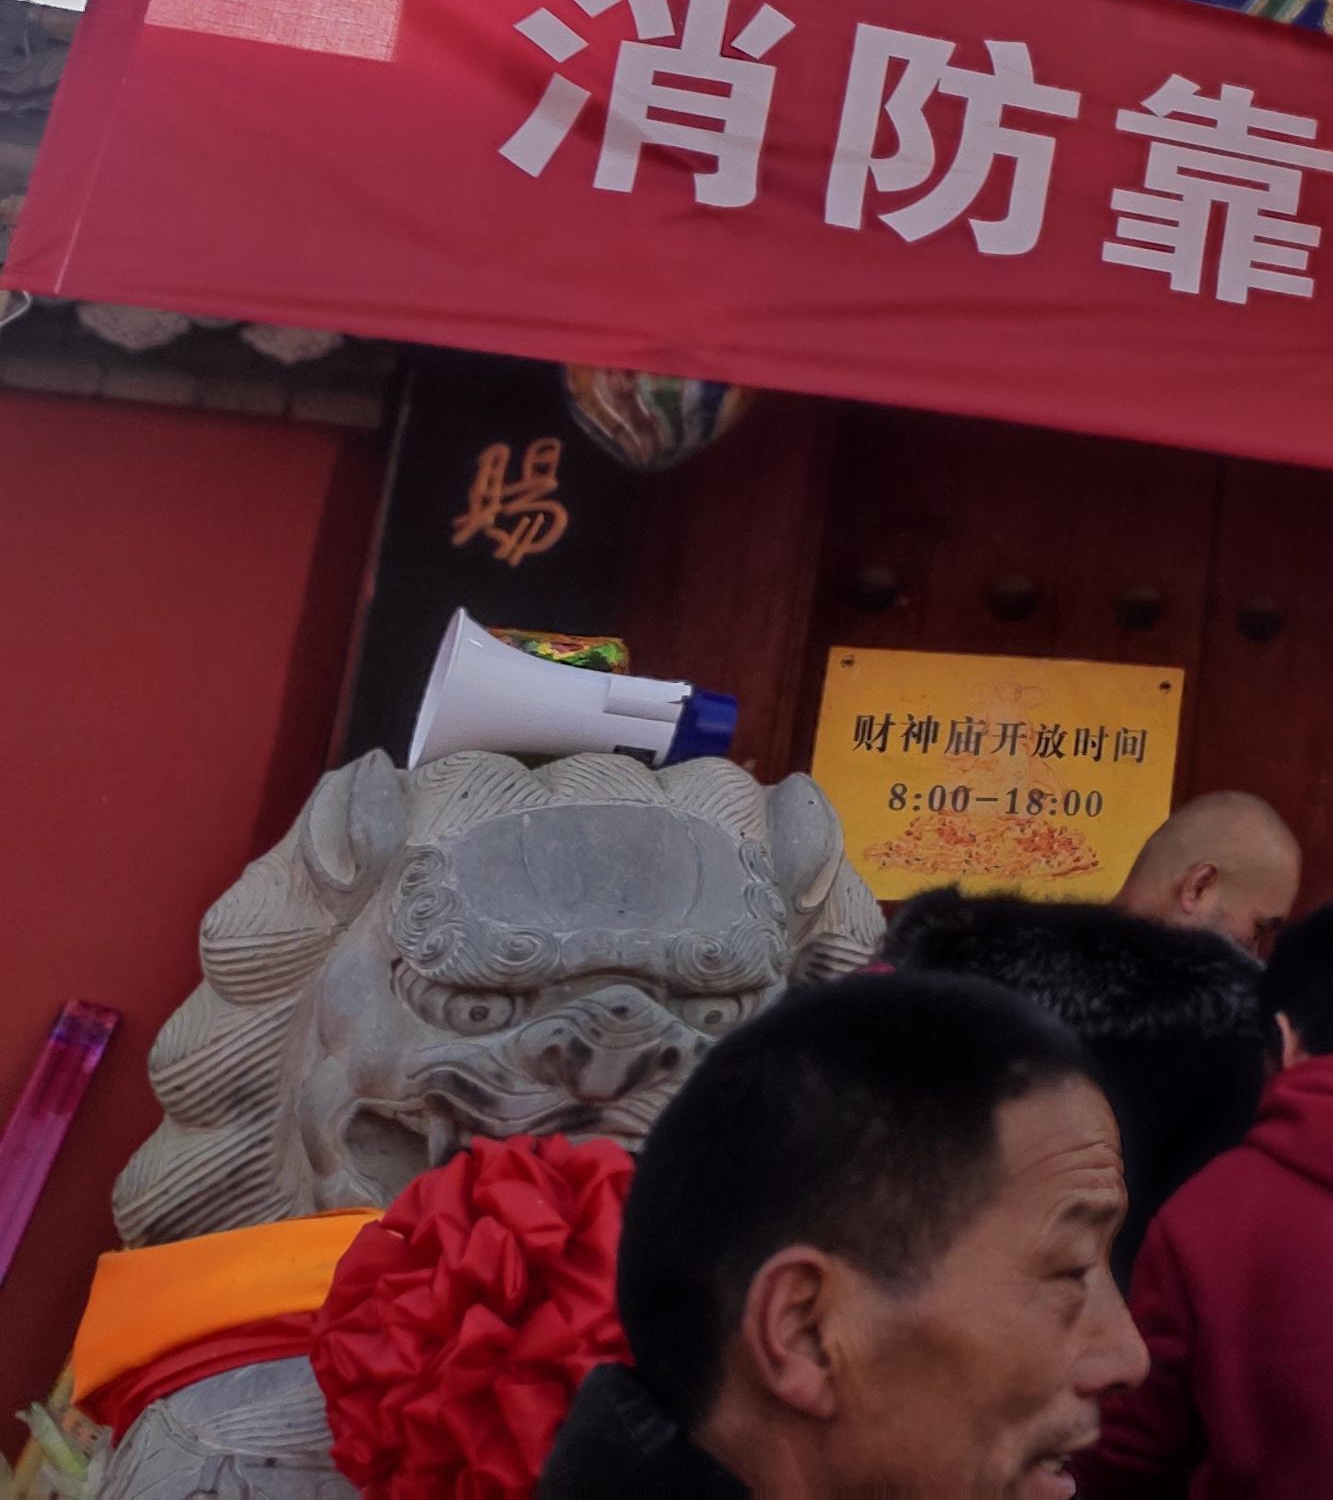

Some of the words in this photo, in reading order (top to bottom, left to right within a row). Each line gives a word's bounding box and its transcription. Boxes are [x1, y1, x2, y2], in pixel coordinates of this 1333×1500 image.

[852, 712, 1149, 764] 财神庙开放时间
